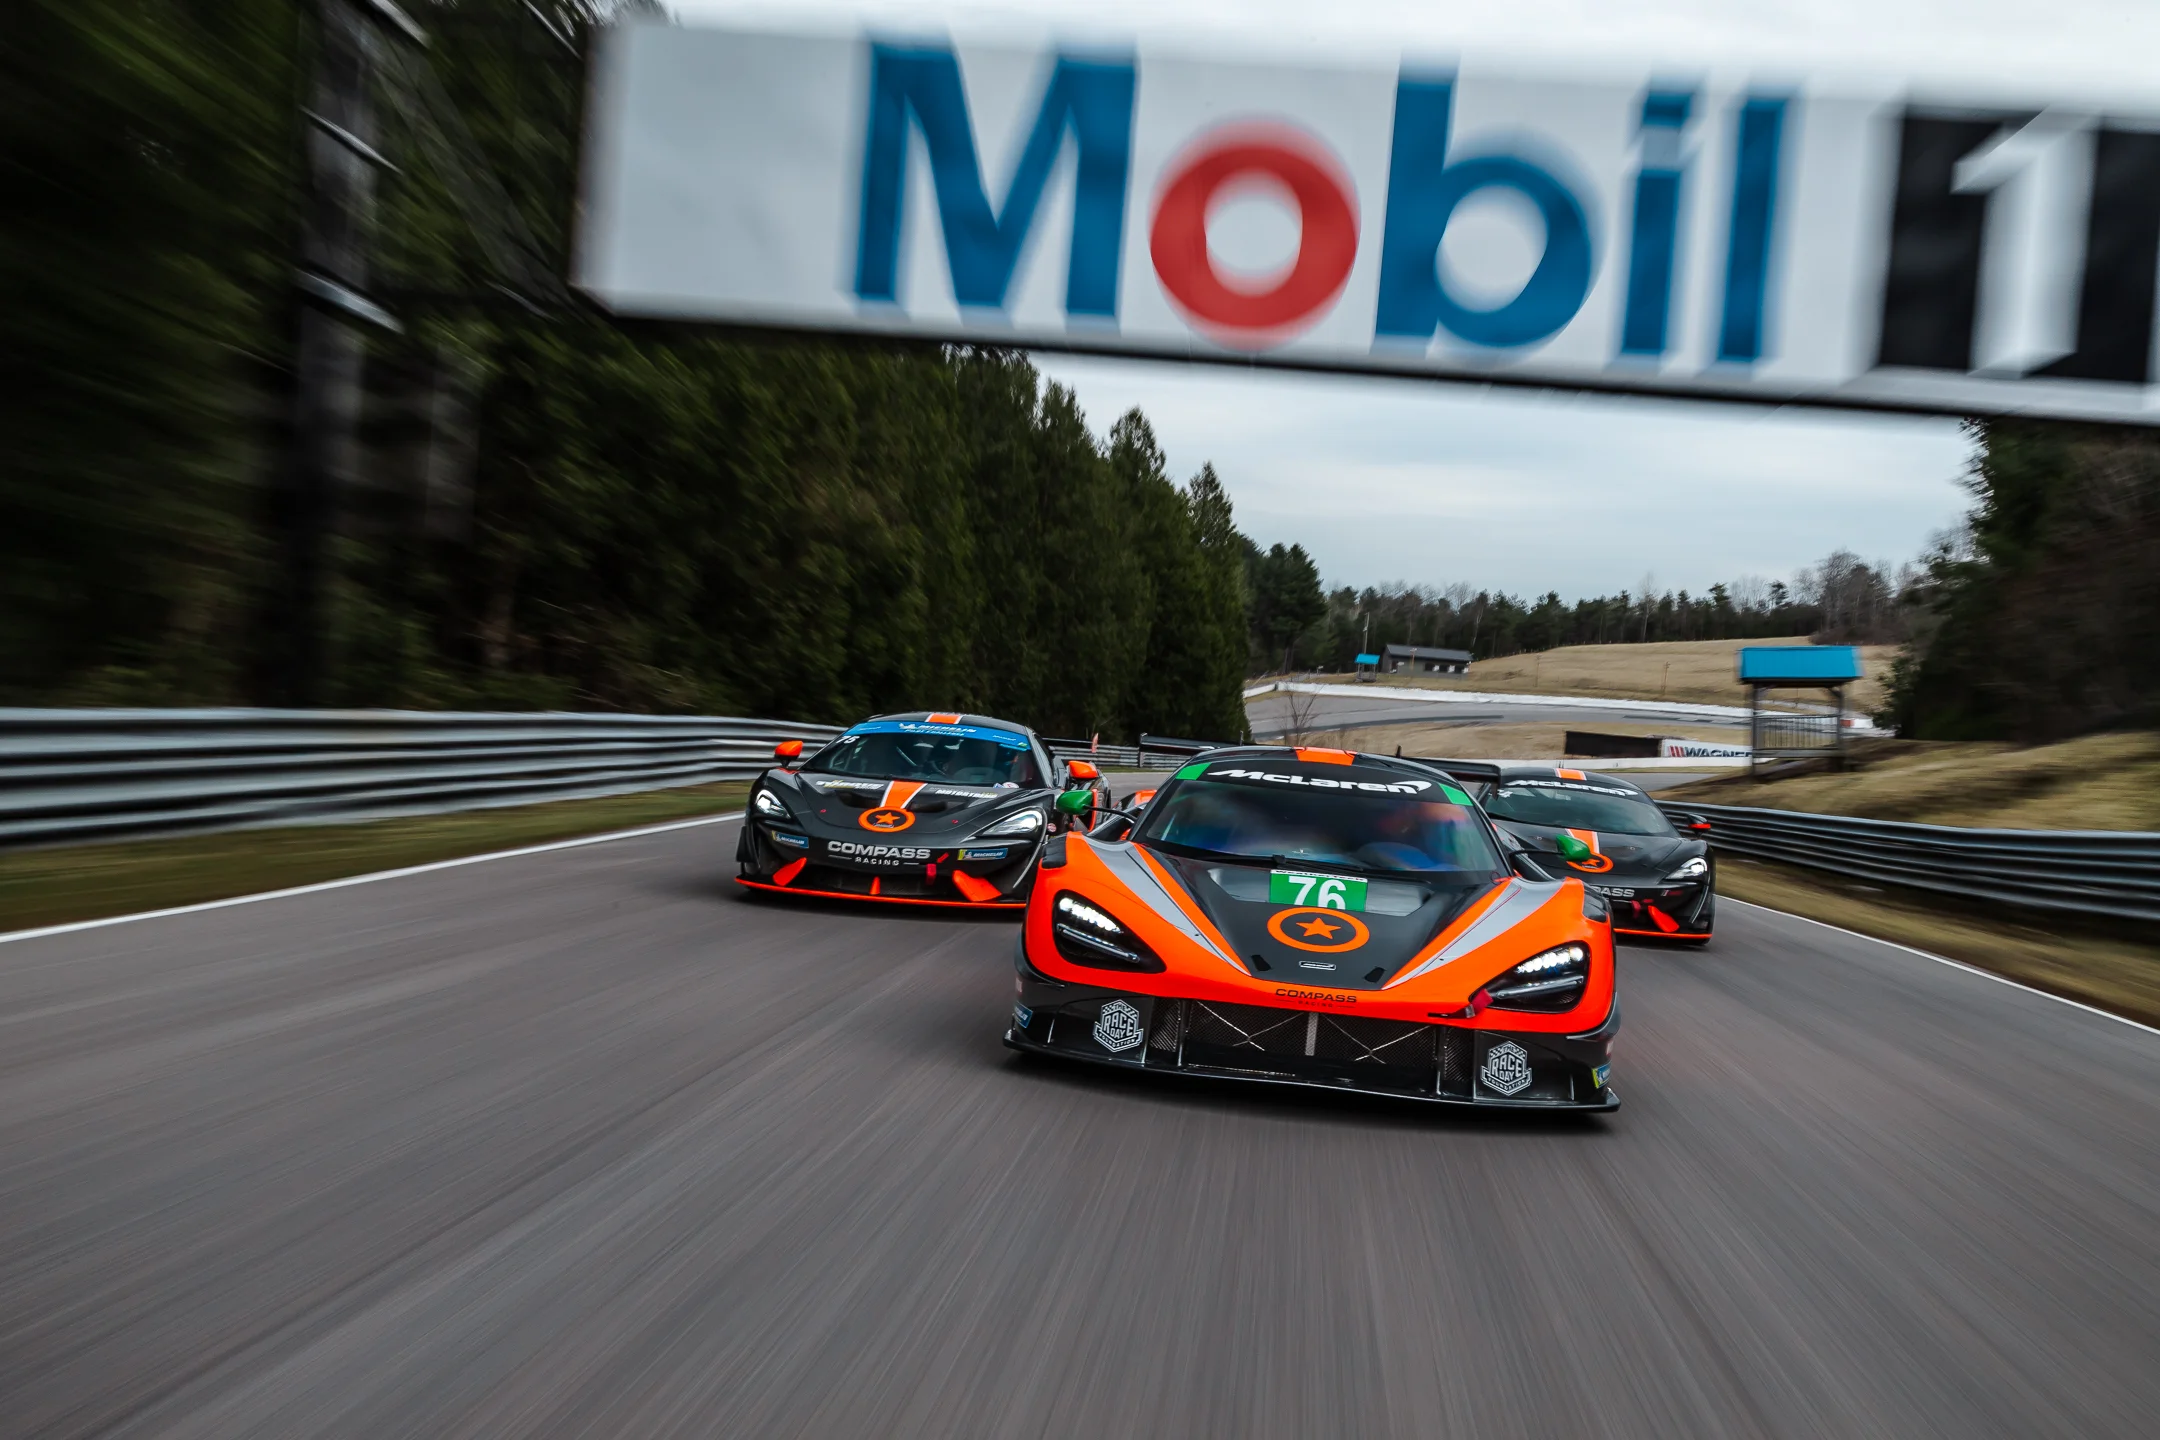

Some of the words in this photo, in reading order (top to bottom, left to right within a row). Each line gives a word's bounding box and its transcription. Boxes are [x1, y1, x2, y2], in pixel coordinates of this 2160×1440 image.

[853, 42, 1796, 370] Mobil
[1953, 106, 2098, 378] 1
[1207, 769, 1432, 794] McLaren
[1505, 780, 1639, 797] McLaren
[828, 840, 931, 860] COMPASS
[973, 850, 1004, 859] MICHELIN
[855, 857, 900, 866] RACING
[1288, 875, 1347, 911] 76
[1275, 988, 1357, 1003] COMPASS
[1298, 1000, 1333, 1008] RACING
[1104, 1011, 1134, 1037] RACE
[1098, 1033, 1136, 1048] FOUNDATION
[1110, 1028, 1125, 1039] DAY
[1491, 1054, 1523, 1078] RACE
[1500, 1070, 1515, 1081] DAY
[1488, 1078, 1526, 1091] FOUNDATION
